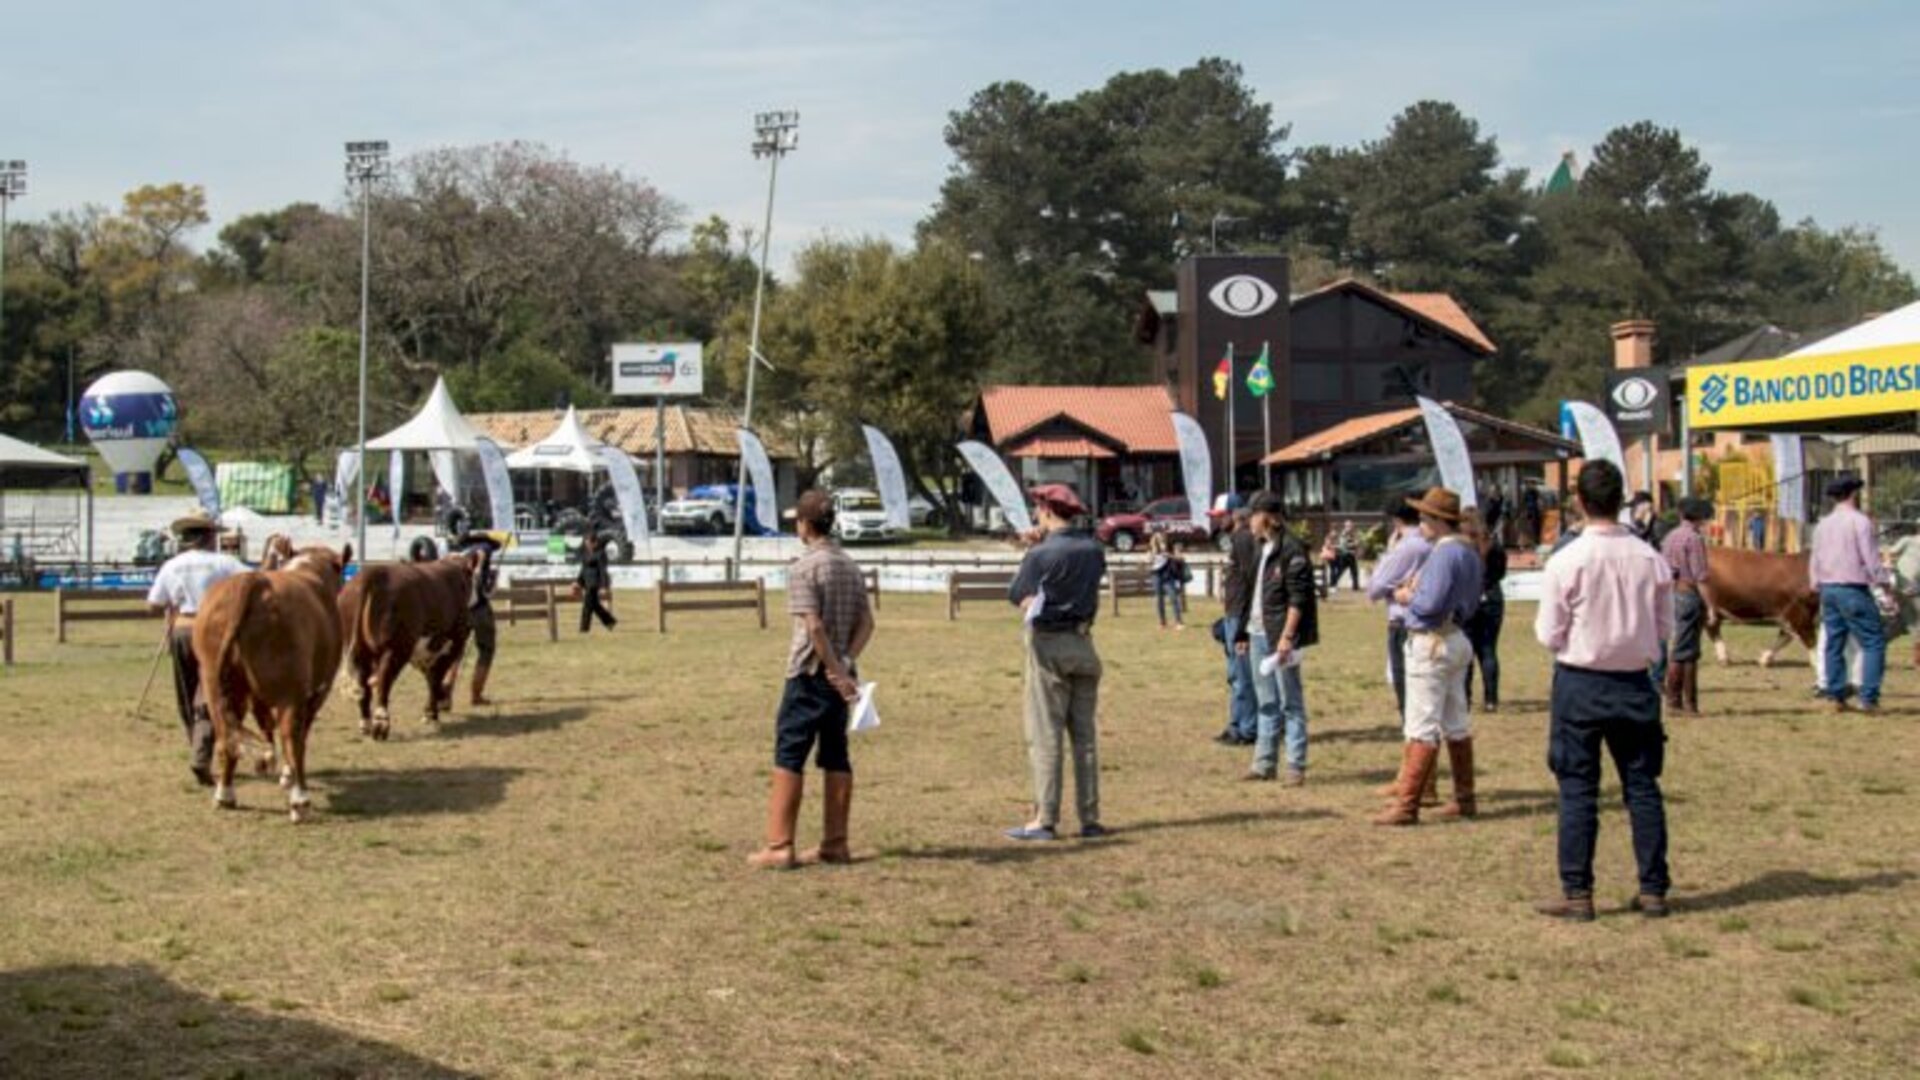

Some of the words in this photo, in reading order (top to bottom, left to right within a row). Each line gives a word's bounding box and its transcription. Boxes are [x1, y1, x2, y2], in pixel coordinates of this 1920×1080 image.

[1734, 375, 1811, 406] BANCO
[1815, 371, 1846, 399] DO
[1849, 364, 1920, 396] BRASI
